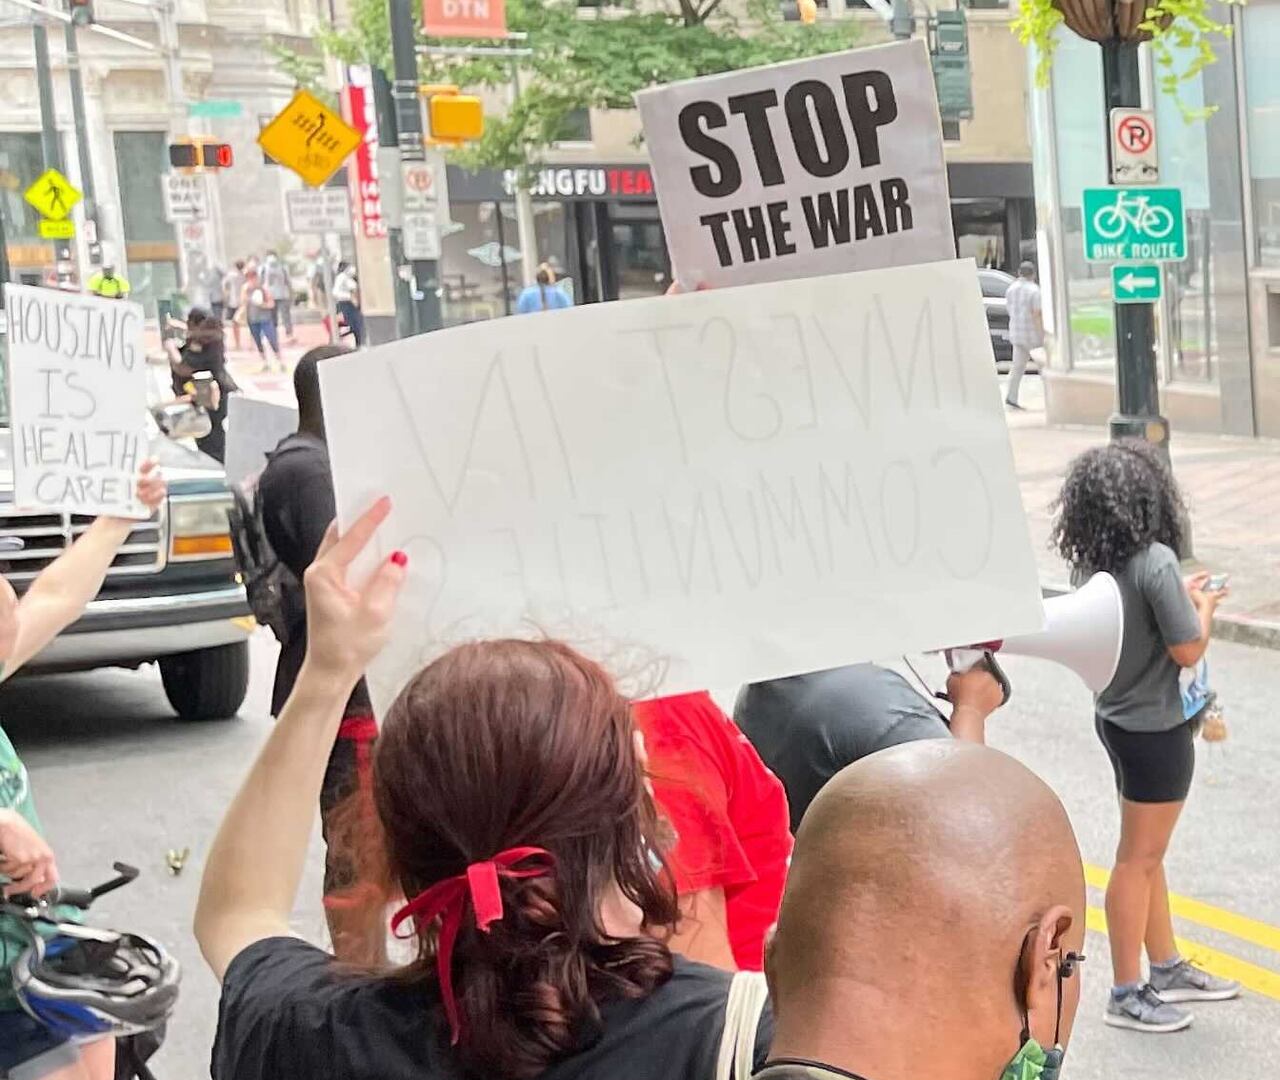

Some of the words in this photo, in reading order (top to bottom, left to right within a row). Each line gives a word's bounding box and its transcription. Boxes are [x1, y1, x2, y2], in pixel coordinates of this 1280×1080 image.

[678, 70, 898, 198] STOP
[700, 201, 797, 267] THE
[801, 177, 914, 250] WAR
[1092, 242, 1125, 258] BIKE
[1131, 242, 1179, 258] ROUTE
[9, 294, 137, 371] HOUSING
[38, 368, 97, 420] IS
[21, 423, 138, 474] HEALTH
[35, 472, 134, 512] CARE!
